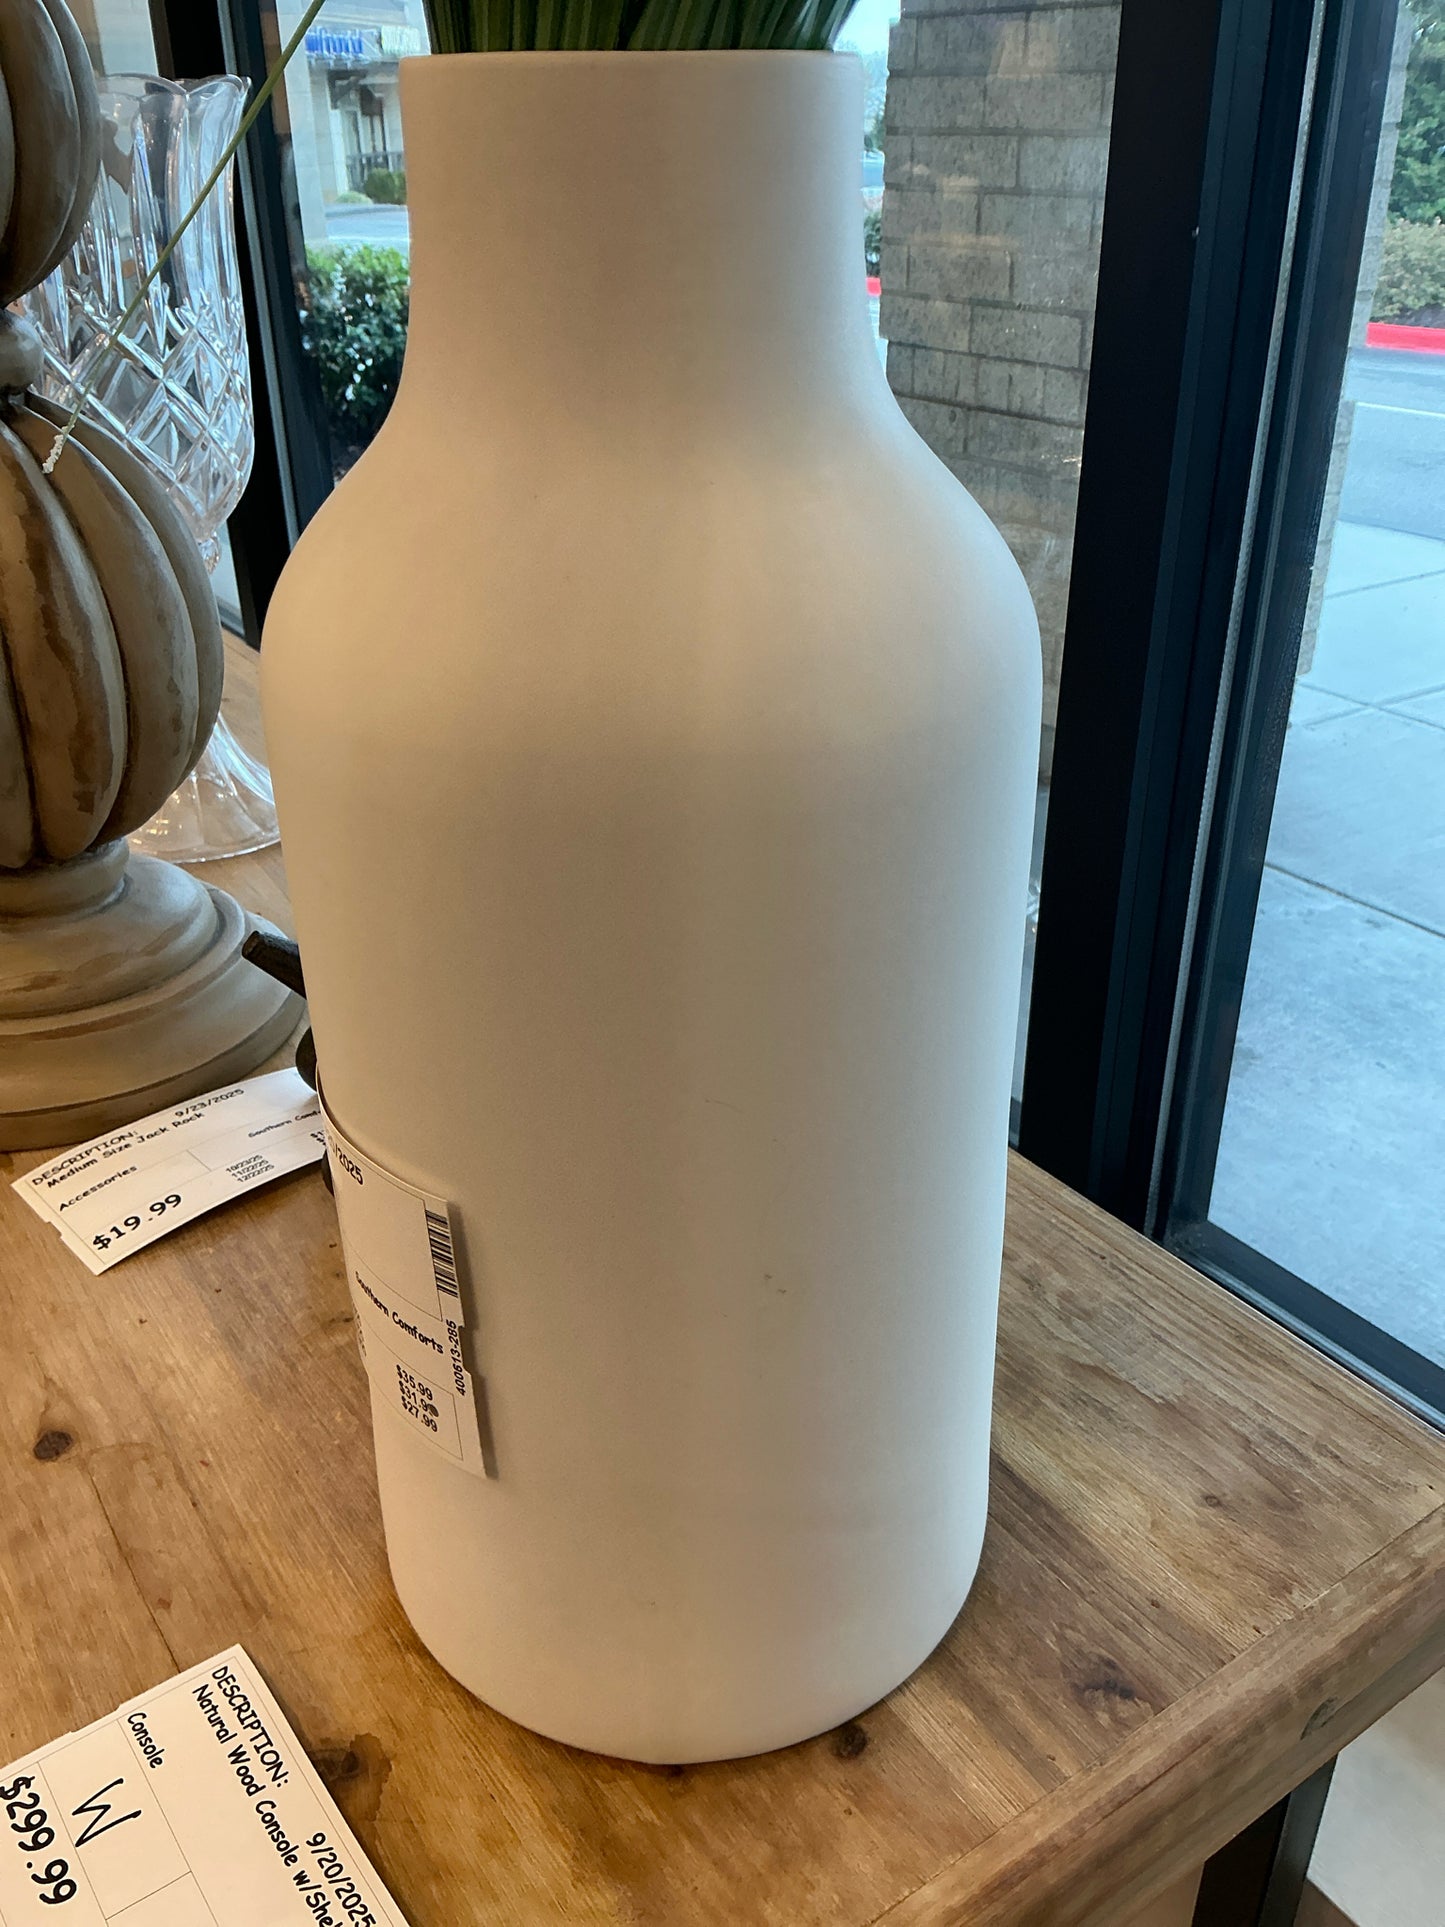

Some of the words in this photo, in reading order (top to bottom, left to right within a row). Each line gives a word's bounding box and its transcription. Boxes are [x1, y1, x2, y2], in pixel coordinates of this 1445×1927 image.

[175, 1088, 245, 1117] 9/23/2025
[31, 1130, 138, 1186] DESCRIPTION:
[47, 1158, 98, 1188] Medium
[102, 1143, 132, 1158] Size
[137, 1126, 170, 1144] Jack
[172, 1112, 205, 1128] Rock
[59, 1166, 137, 1212] Accessories
[92, 1193, 182, 1251] $19.99
[392, 1311, 444, 1354] Comforts
[446, 1319, 466, 1396] 400613-285
[396, 1364, 433, 1401] $35.99
[399, 1380, 439, 1417] $31.9
[401, 1396, 438, 1432] $27.99
[127, 1711, 164, 1769] Console
[211, 1665, 289, 1787] DESCRIPTION:
[192, 1683, 238, 1745] Natural
[227, 1743, 266, 1797] Wood
[255, 1800, 300, 1867] Console
[293, 1869, 343, 1927] w/She
[0, 1776, 77, 1904] $299.99
